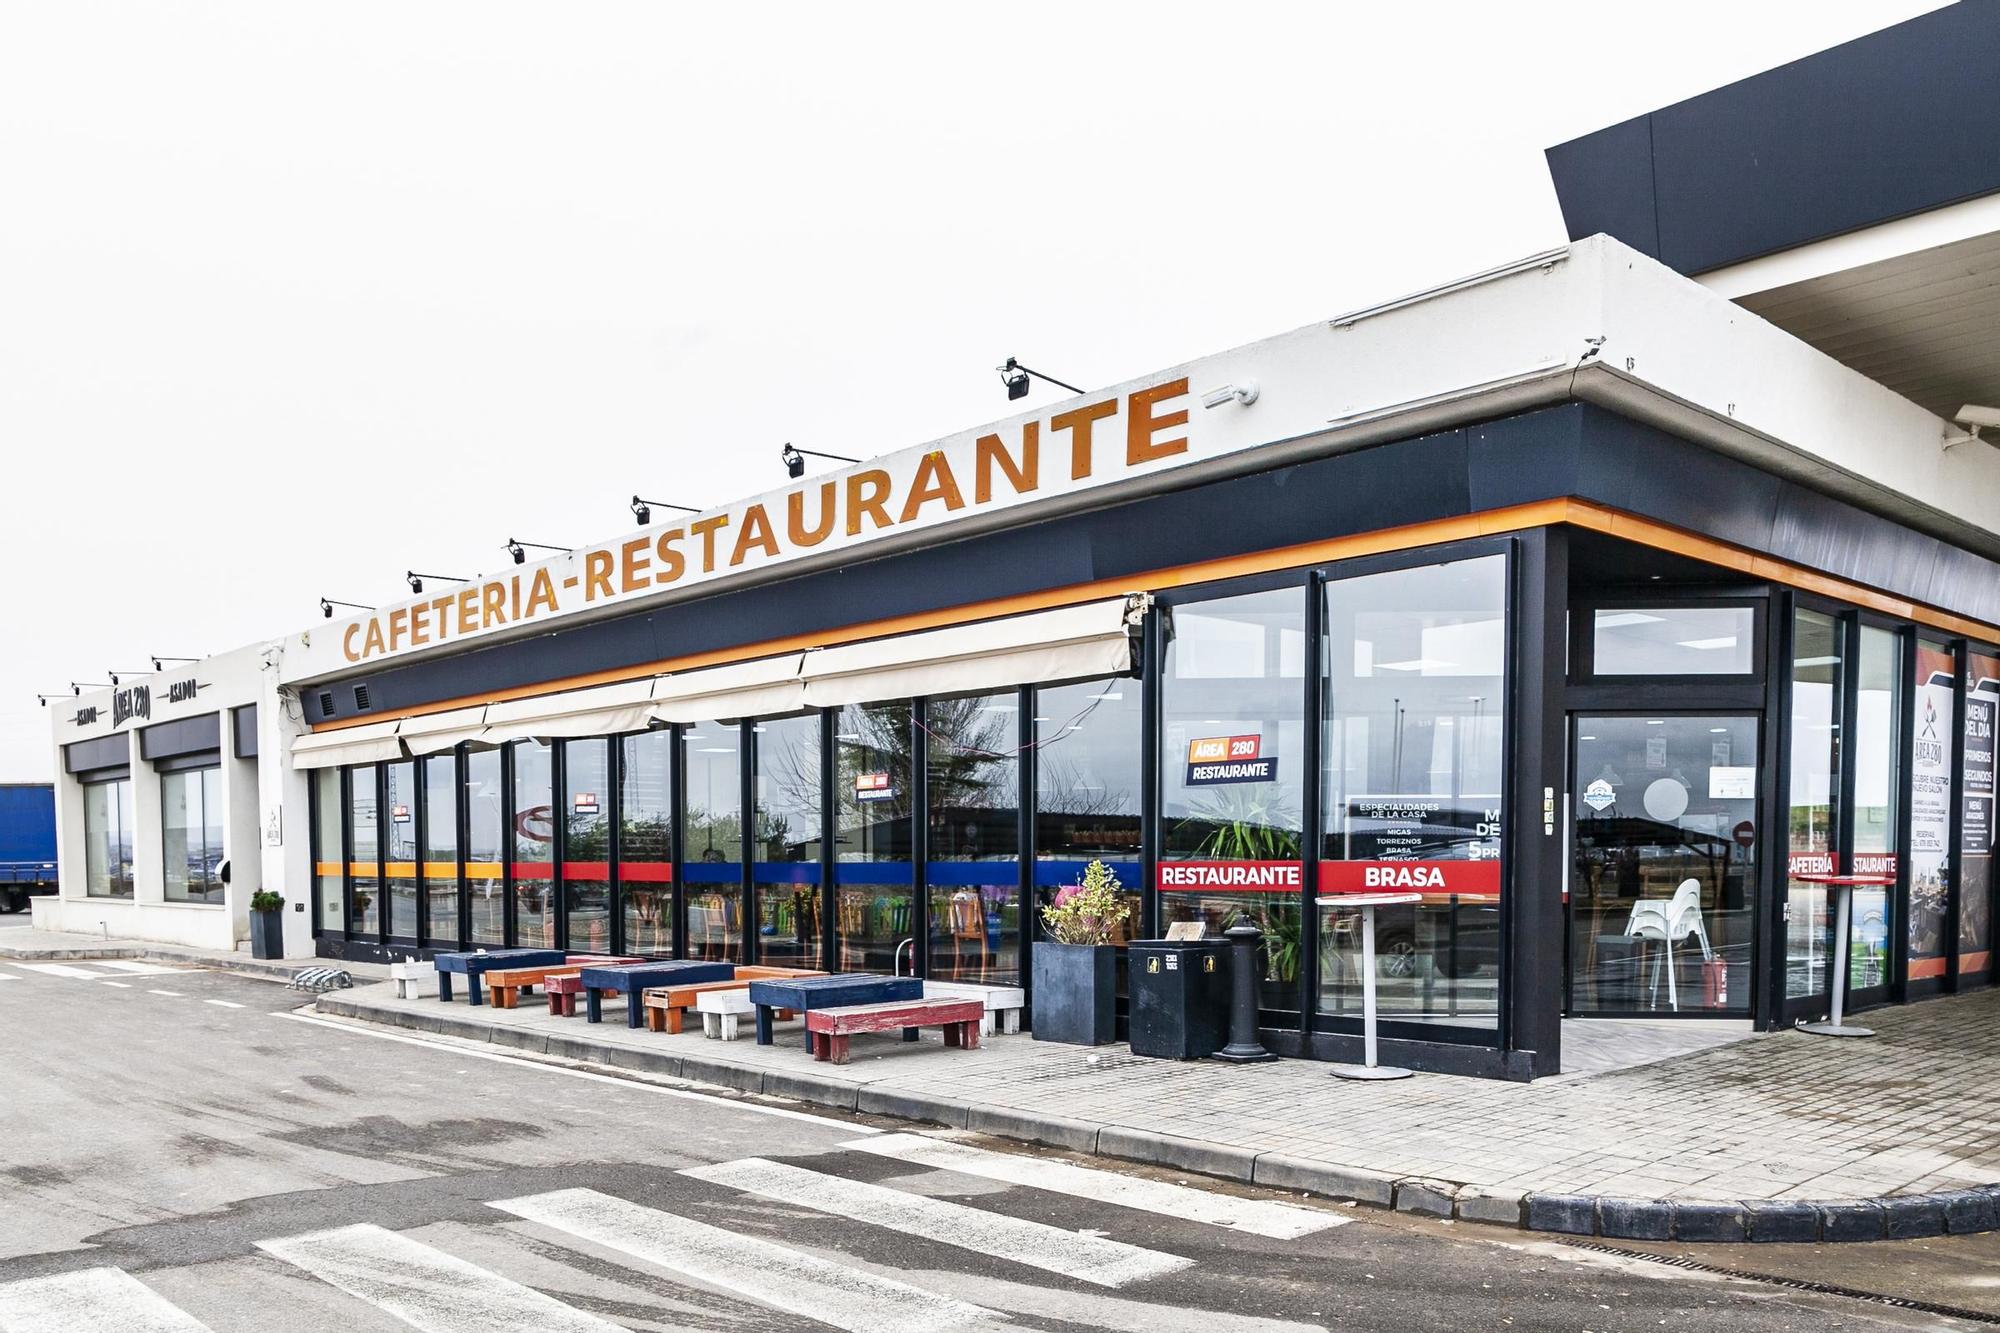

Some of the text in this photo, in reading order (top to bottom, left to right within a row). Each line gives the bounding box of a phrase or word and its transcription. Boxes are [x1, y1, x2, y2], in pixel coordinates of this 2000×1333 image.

[343, 376, 1190, 663] CAFETERIA-RESTAURANTE
[133, 685, 151, 721] 280
[1967, 703, 1989, 721] MENÚ
[1195, 740, 1255, 758] ÁREA 280
[1193, 762, 1269, 780] RESTAURANTE
[1359, 803, 1440, 811] ESPECIALIDADES
[1371, 811, 1428, 819] DE LA CASA
[1484, 809, 1500, 822] M
[1161, 866, 1300, 885] RESTAURANTE
[1365, 867, 1446, 887] BRASA
